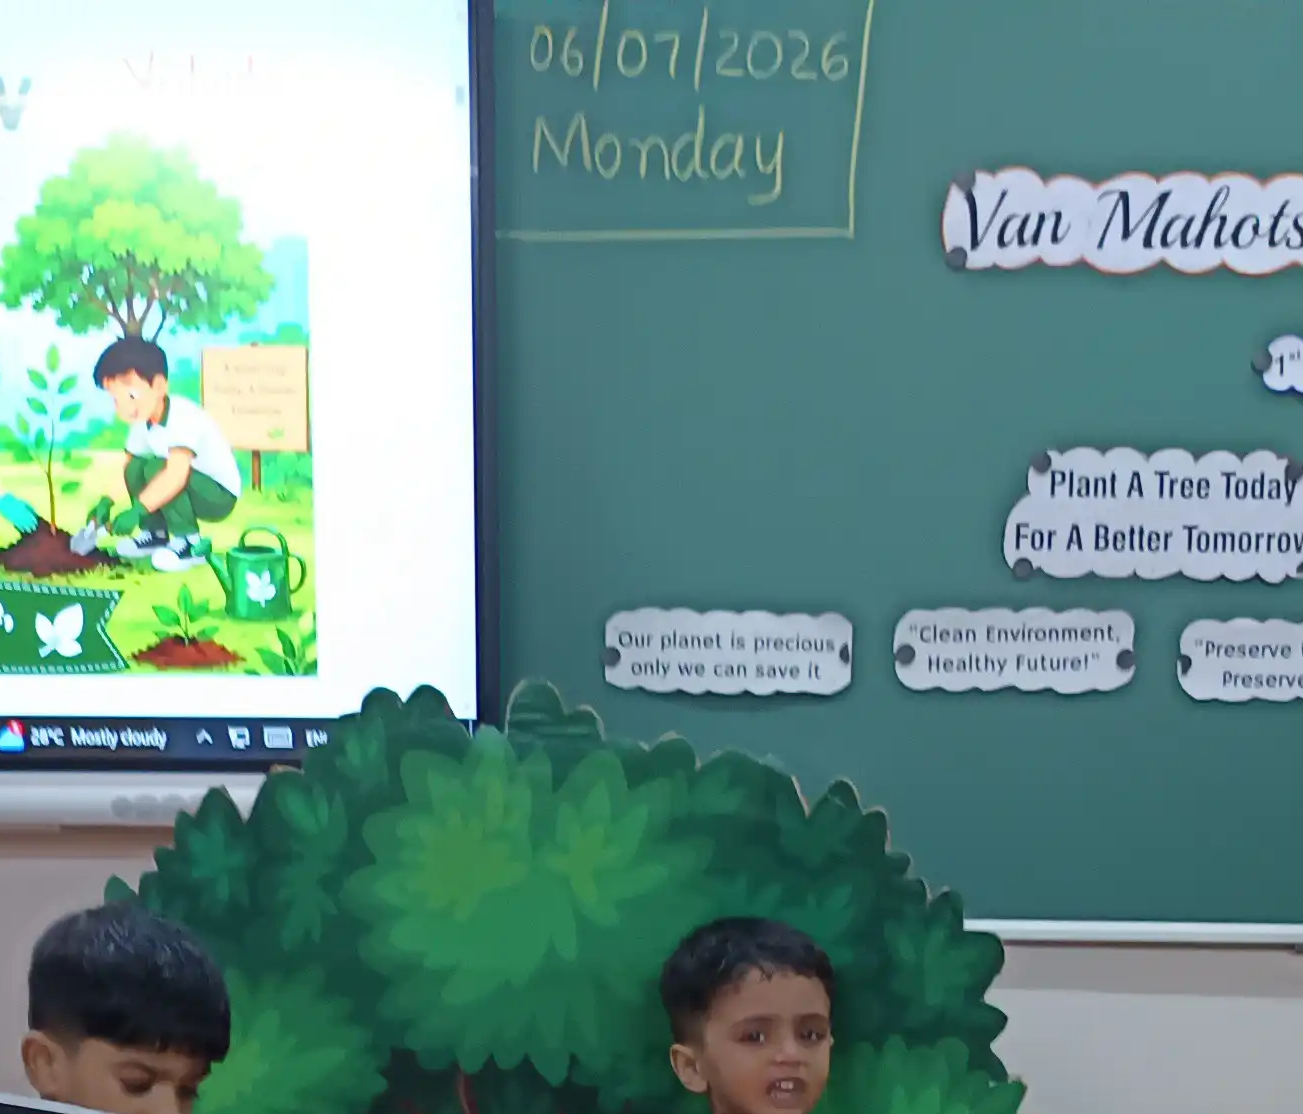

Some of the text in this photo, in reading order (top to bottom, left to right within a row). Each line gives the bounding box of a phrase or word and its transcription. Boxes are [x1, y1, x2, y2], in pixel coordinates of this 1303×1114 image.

[530, 0, 850, 92] 06/07/2026
[533, 104, 785, 206] Monday
[961, 187, 1070, 251] Van
[1049, 469, 1298, 507] Plant A Tree Today
[1014, 522, 1057, 551] For
[1065, 524, 1084, 551] A
[1093, 524, 1173, 552] Better
[618, 629, 836, 655] Our planet is precious
[909, 623, 1121, 644] "Clean Environment,
[1194, 638, 1292, 660] "Preserve
[631, 658, 822, 680] only we can save it
[927, 652, 1101, 676] Healthy Future!"
[69, 725, 119, 751] Mostly
[119, 725, 167, 751] cloudy
